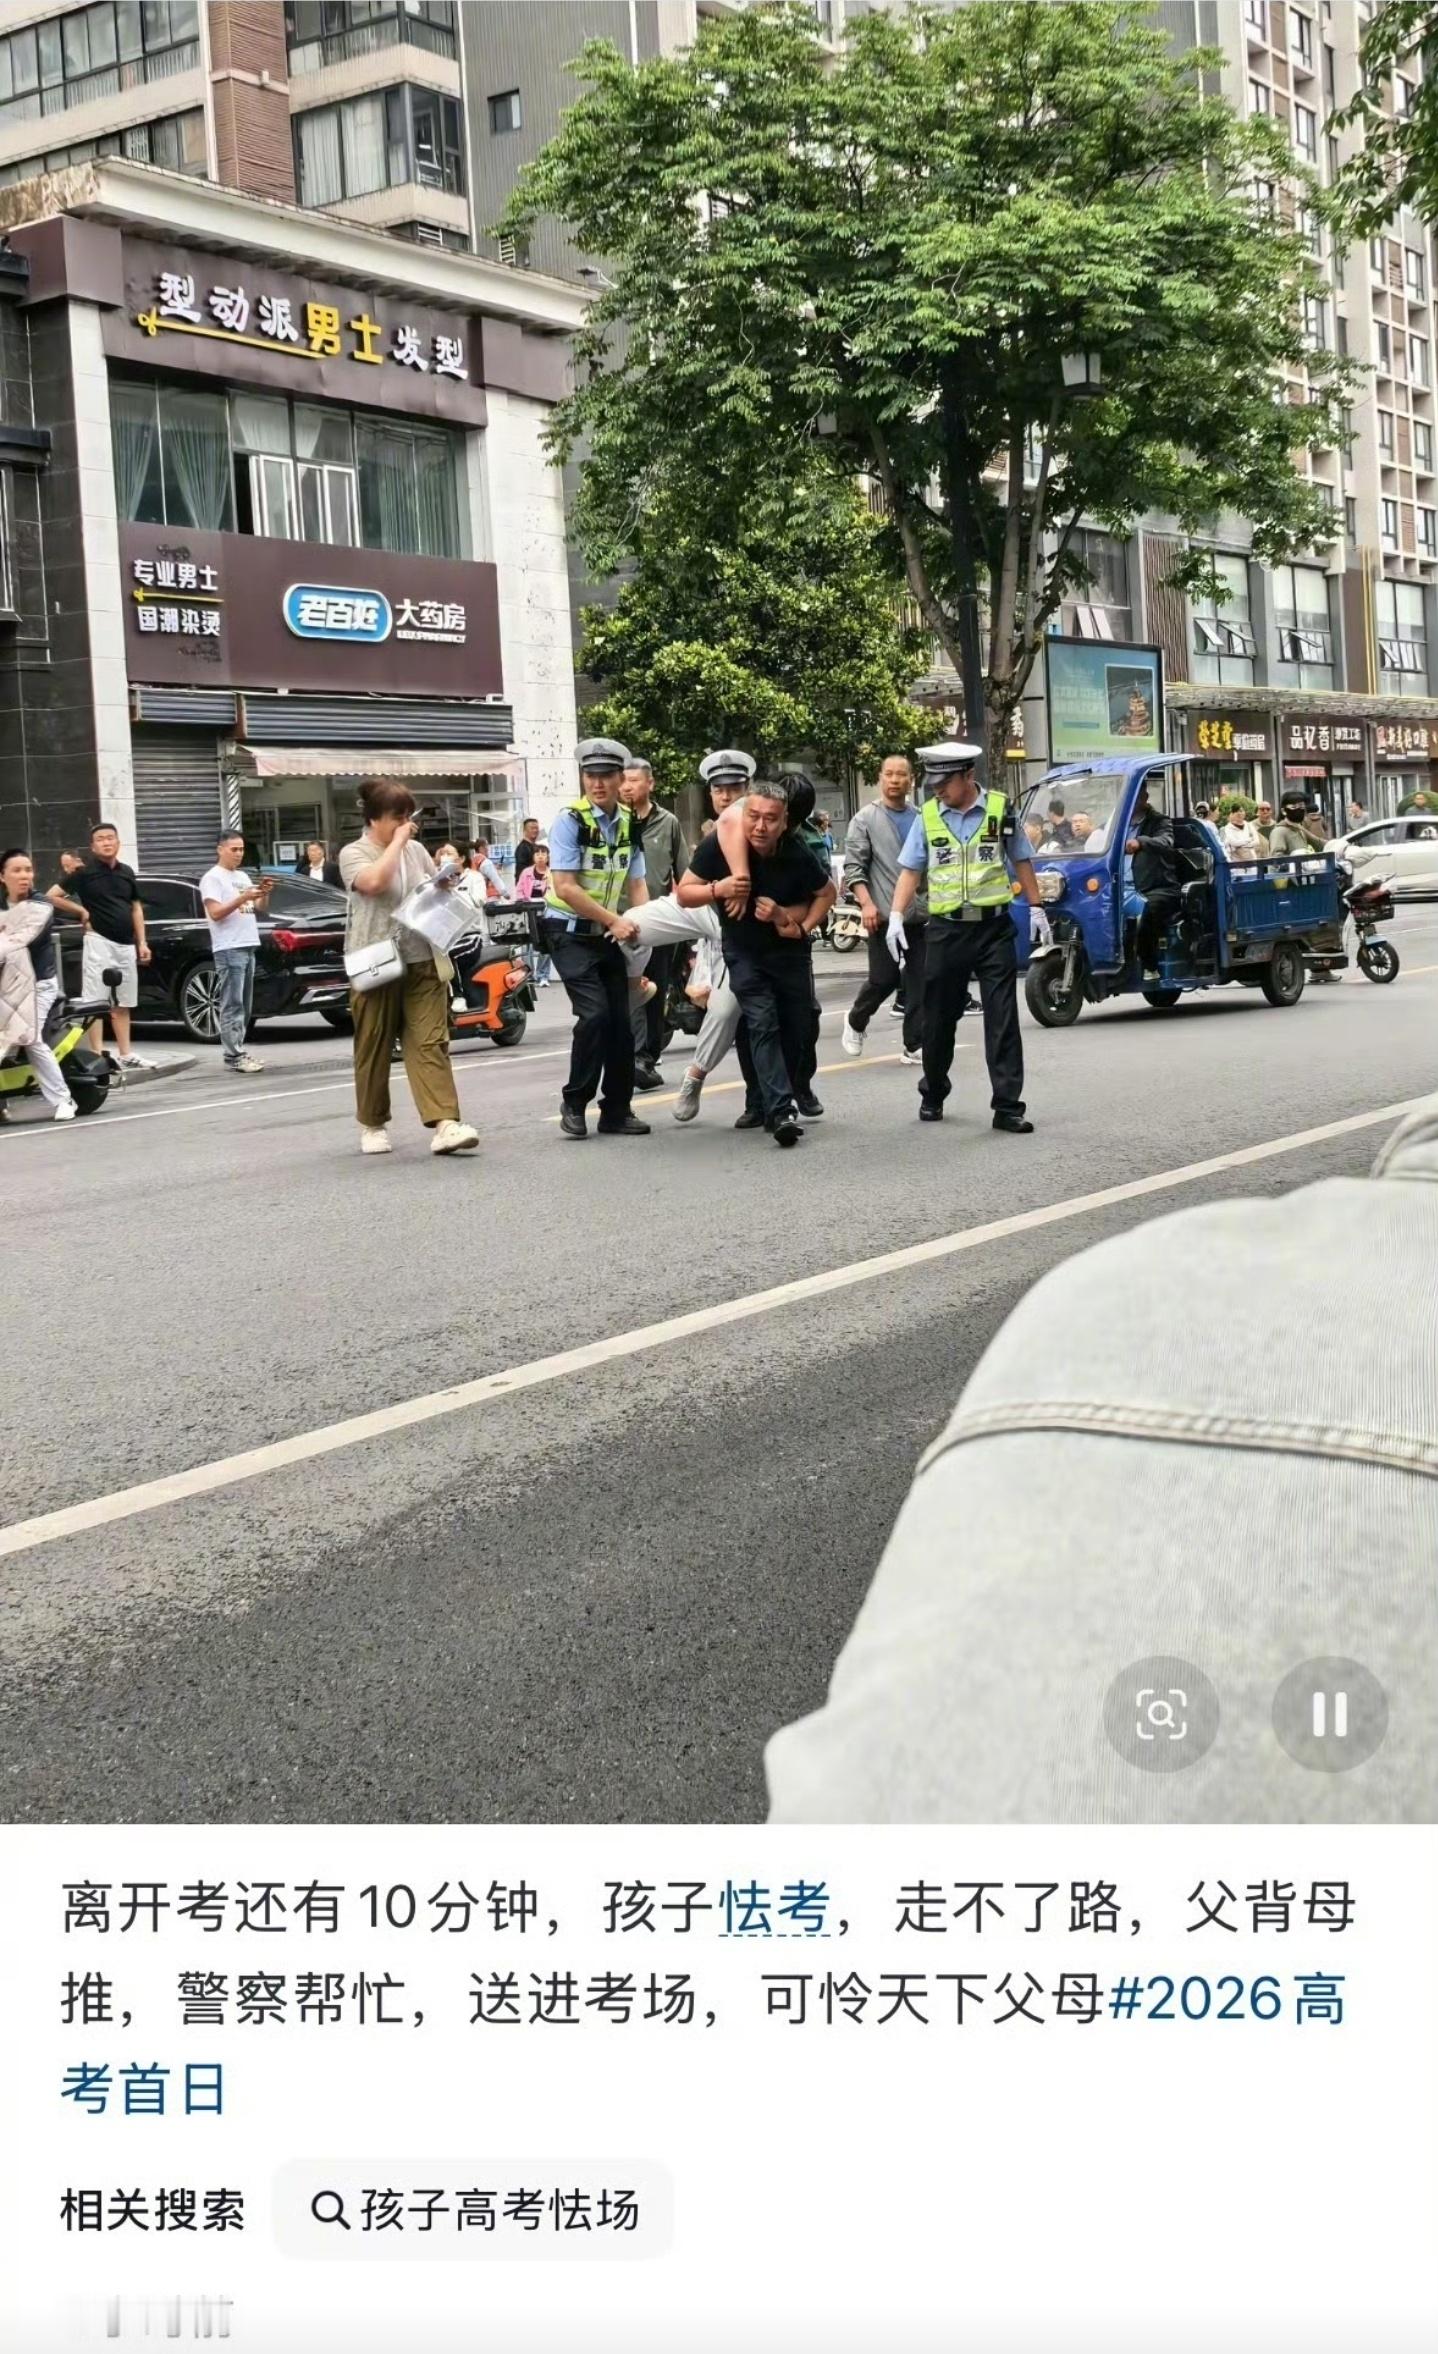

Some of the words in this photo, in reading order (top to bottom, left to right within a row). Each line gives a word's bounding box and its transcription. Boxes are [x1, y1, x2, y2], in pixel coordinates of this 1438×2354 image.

[159, 271, 468, 380] 型动派男士发型
[133, 559, 219, 591] 专业男士
[137, 606, 221, 637] 国潮染烫
[298, 594, 381, 631] 老百姓
[395, 599, 467, 630] 大药房
